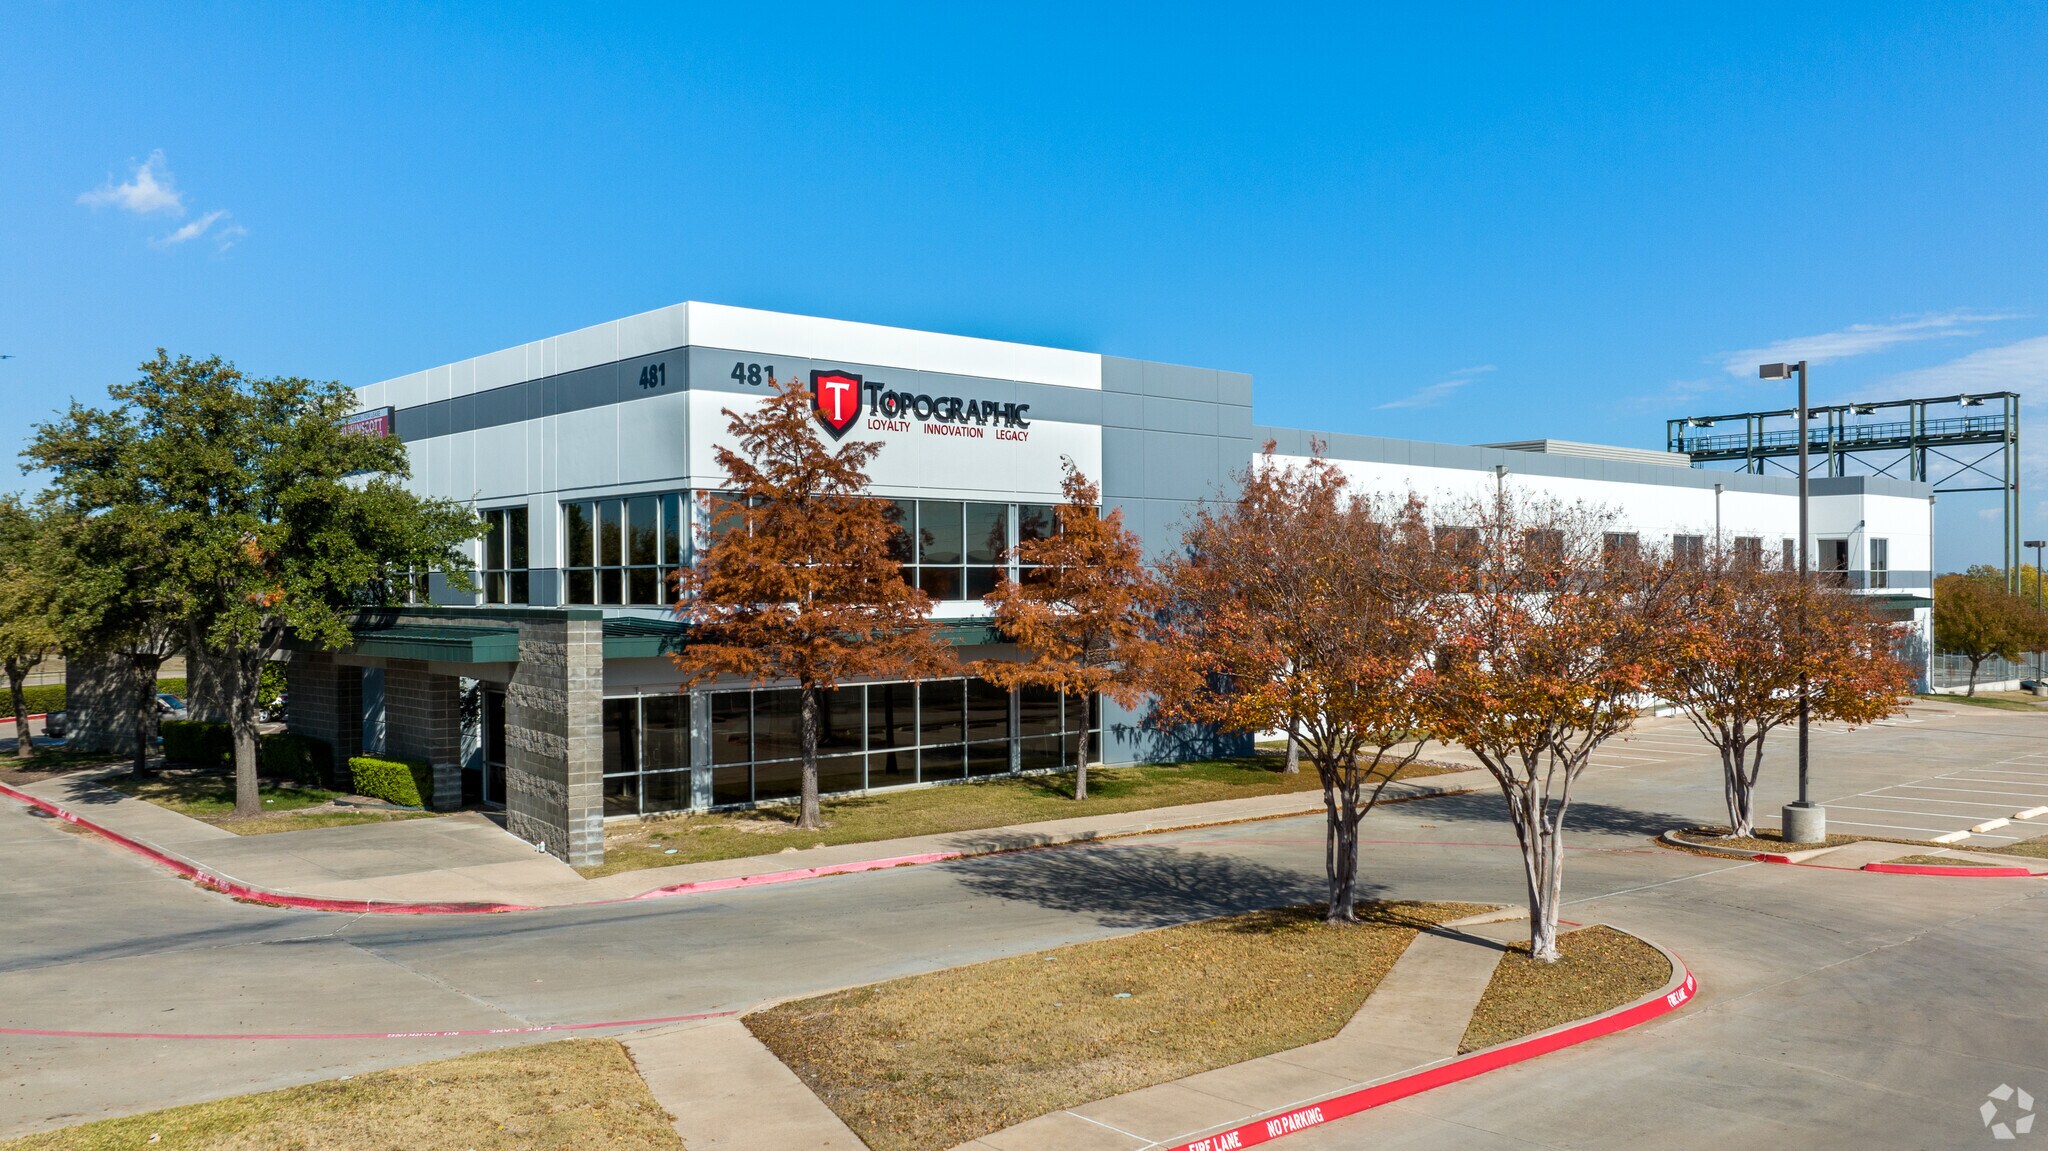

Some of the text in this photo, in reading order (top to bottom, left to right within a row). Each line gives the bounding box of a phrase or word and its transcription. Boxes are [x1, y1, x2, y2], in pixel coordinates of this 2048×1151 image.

[639, 362, 666, 390] 481
[731, 362, 775, 387] 481
[825, 381, 850, 421] T
[863, 381, 1031, 430] TOPOGRAPHIC
[867, 418, 1029, 442] LOYALTY INNOVATION LEGACY
[1213, 1131, 1242, 1151] LANE
[1266, 1120, 1283, 1137] NO
[1281, 1107, 1324, 1132] PARKING
